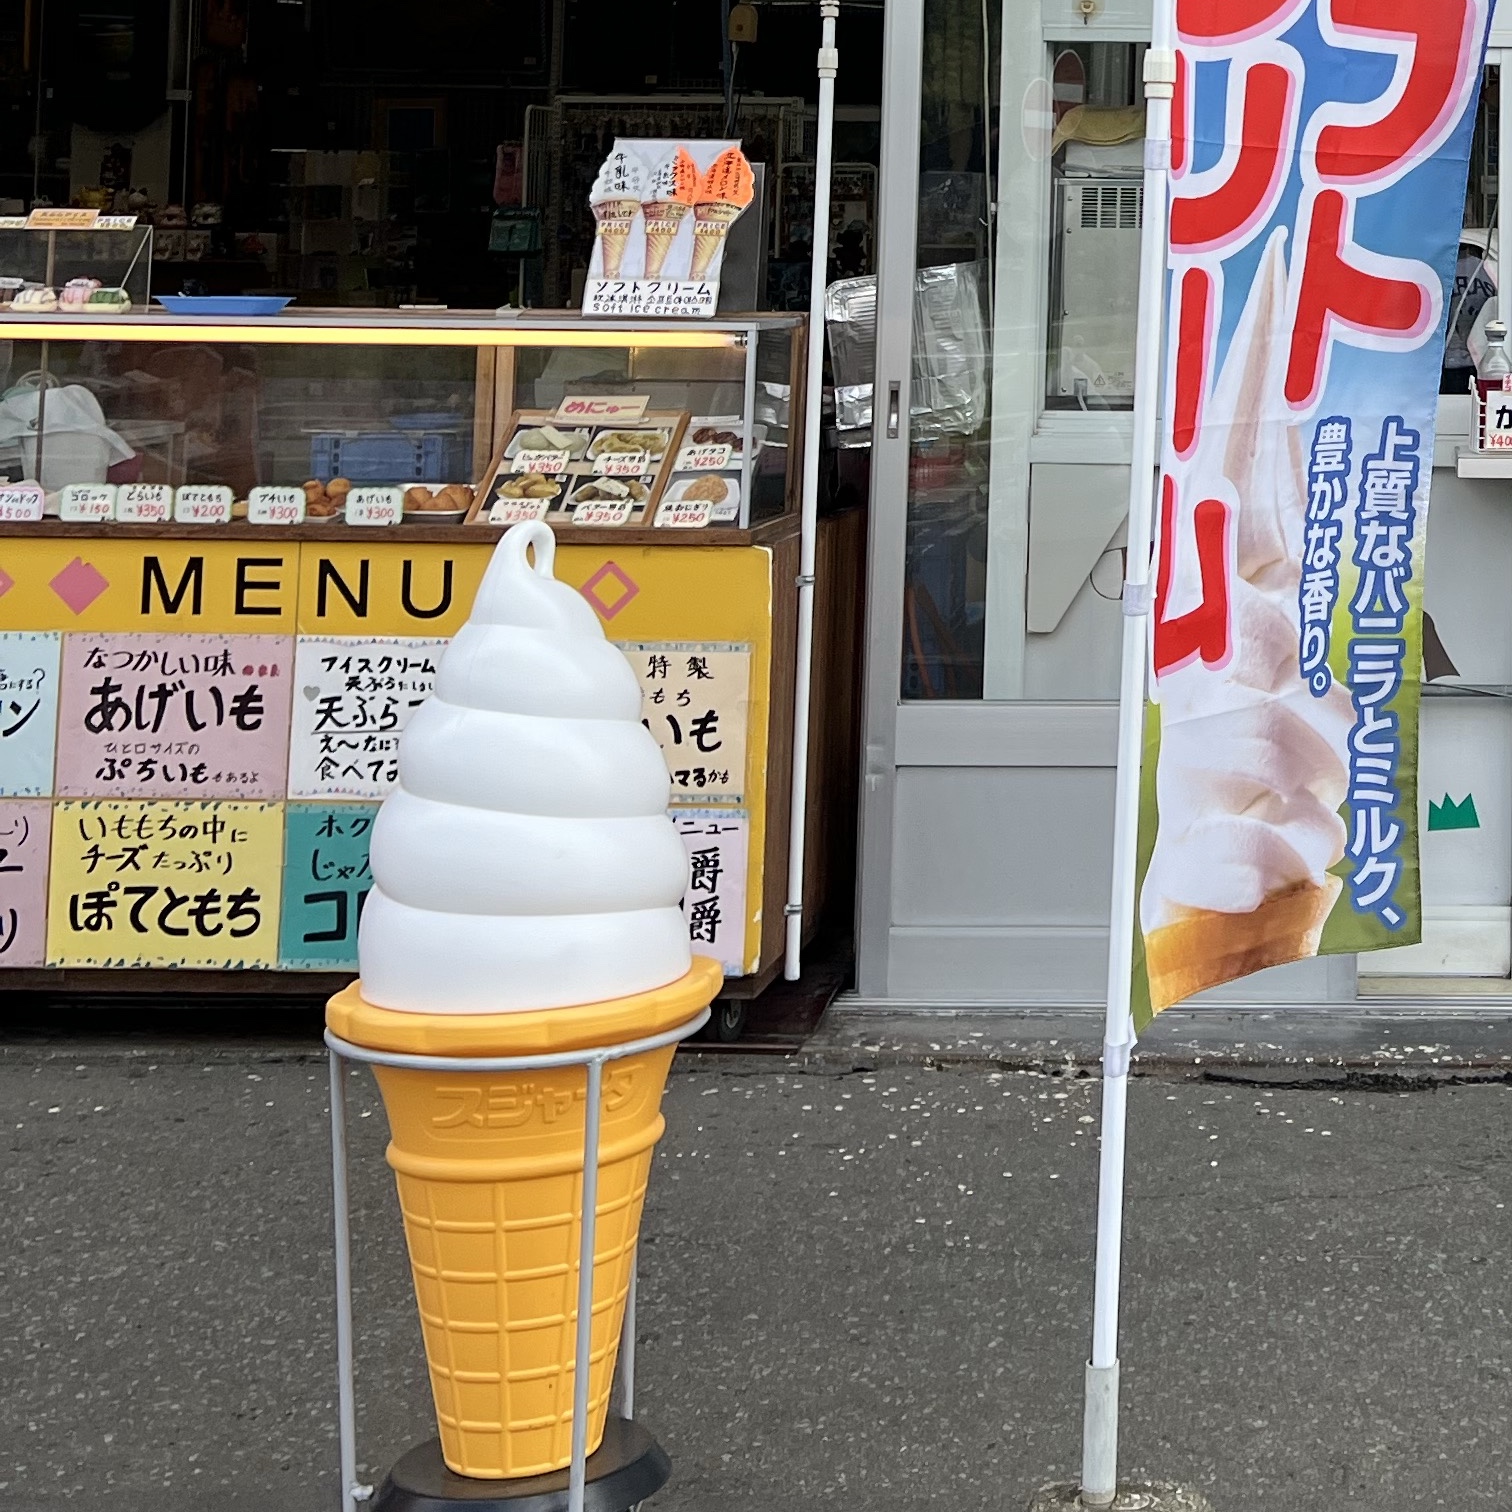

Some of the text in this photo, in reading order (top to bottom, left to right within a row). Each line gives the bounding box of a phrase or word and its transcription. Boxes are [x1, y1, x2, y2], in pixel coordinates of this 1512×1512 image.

[597, 281, 711, 295] ソフトクリーム
[564, 401, 641, 415] めにゅー
[528, 462, 563, 473] ¥350
[694, 456, 725, 467] ¥250
[605, 464, 641, 474] ¥350
[192, 504, 225, 517] ¥200
[269, 506, 298, 520] ¥300
[366, 506, 395, 520] ¥300
[672, 512, 706, 524] ¥250
[1299, 420, 1350, 694] 豊かな香り。
[140, 555, 454, 620] MENU
[646, 654, 715, 680] 特製
[84, 676, 265, 735] あげいも
[104, 741, 201, 756] ひと口サイズの
[79, 813, 249, 844] いももちの中に
[80, 842, 234, 876] チーズたっぷり
[69, 880, 262, 939] ぽてともち
